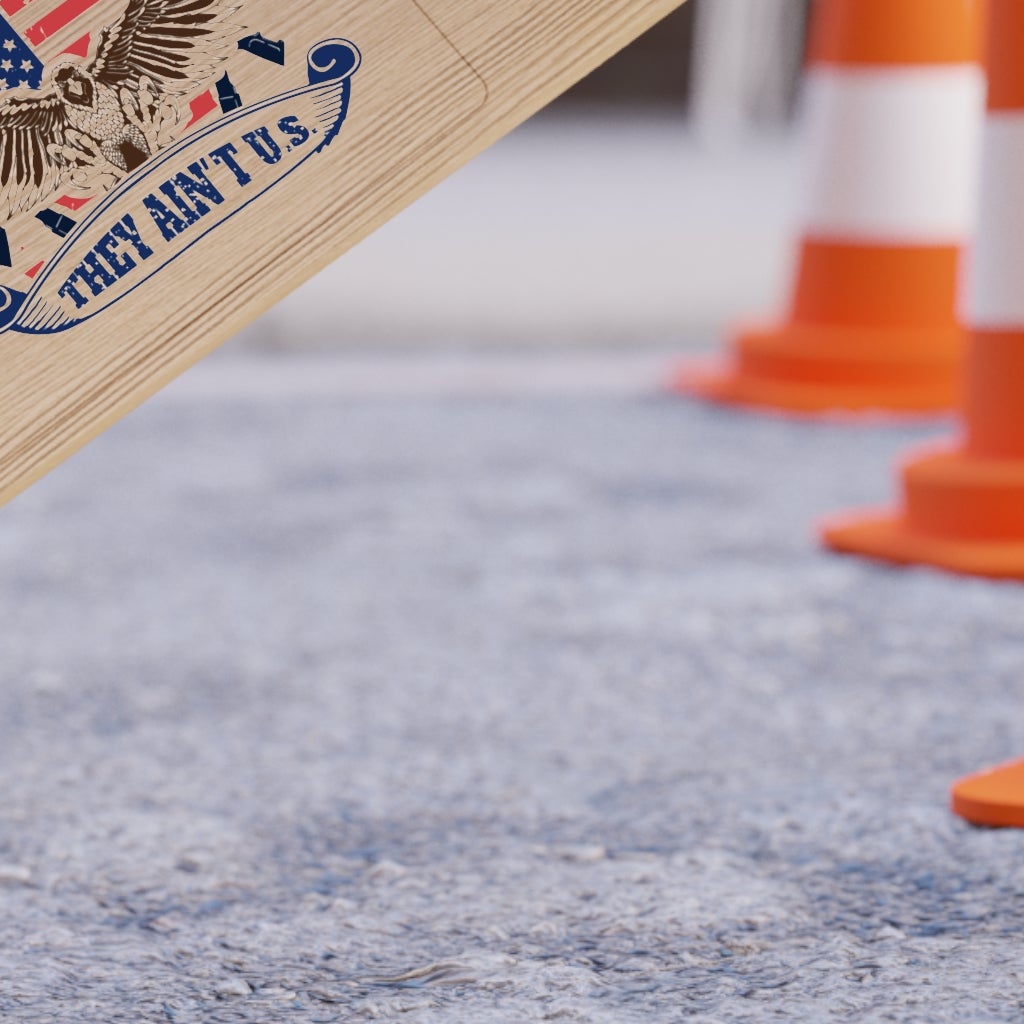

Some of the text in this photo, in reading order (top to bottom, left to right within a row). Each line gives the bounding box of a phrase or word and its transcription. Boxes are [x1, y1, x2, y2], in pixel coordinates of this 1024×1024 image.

[58, 115, 318, 308] THEY AIN'T U.S.
